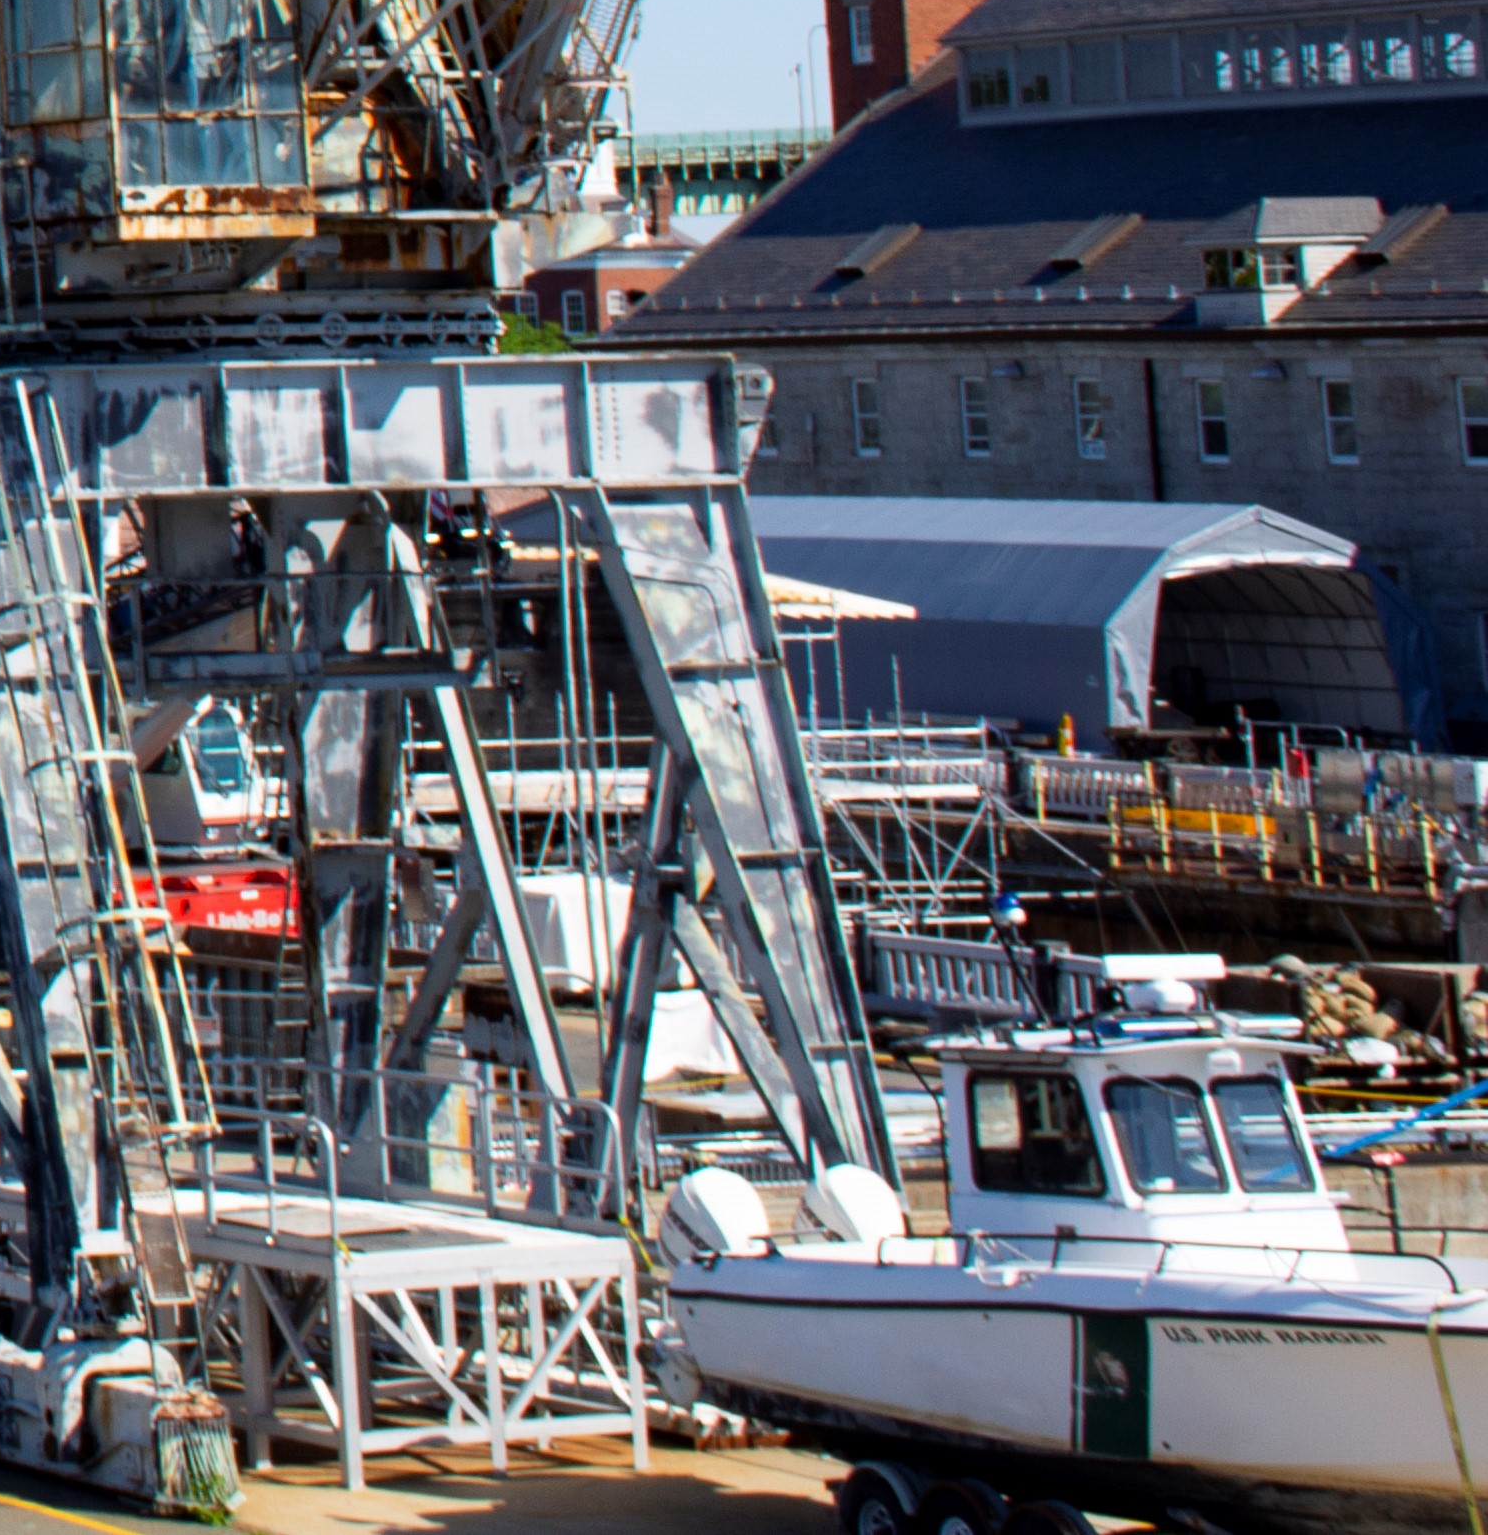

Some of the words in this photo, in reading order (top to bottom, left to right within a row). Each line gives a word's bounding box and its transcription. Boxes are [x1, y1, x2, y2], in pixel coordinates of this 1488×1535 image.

[206, 909, 295, 929] Link-Bet
[1161, 1325, 1204, 1344] U.S.
[1206, 1327, 1272, 1345] PARK
[1274, 1329, 1387, 1345] RANGER
